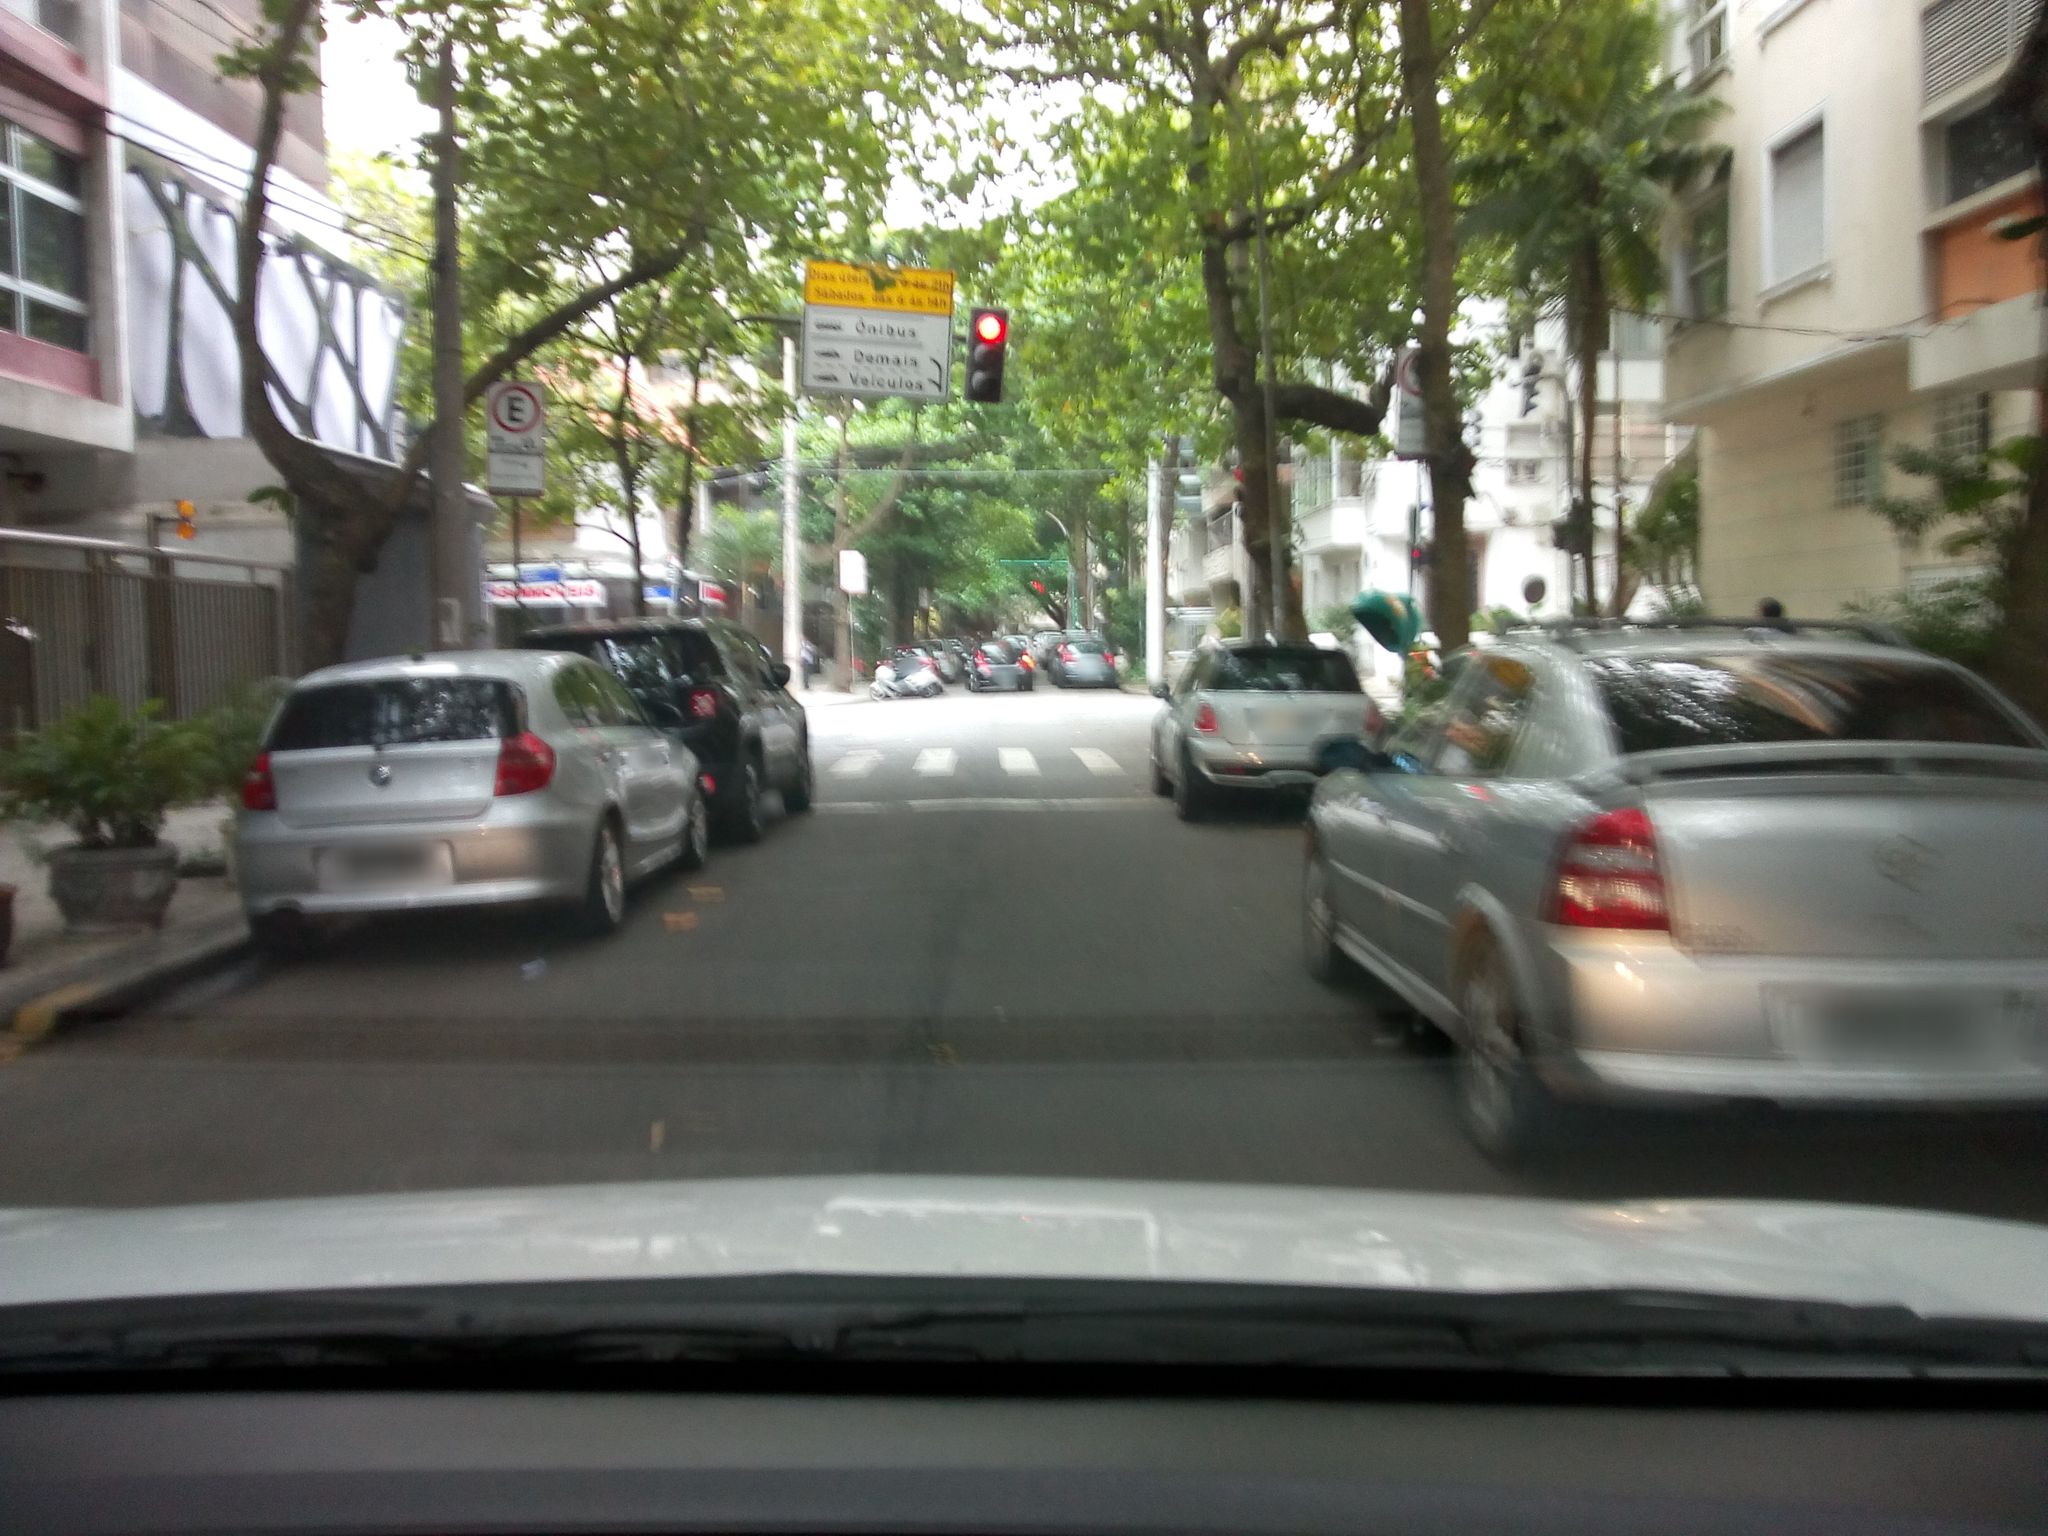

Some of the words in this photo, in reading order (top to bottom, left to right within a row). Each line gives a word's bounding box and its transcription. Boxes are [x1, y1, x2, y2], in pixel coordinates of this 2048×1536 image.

[855, 315, 917, 339] Ônibus
[853, 348, 919, 369] Demais
[507, 396, 525, 423] E
